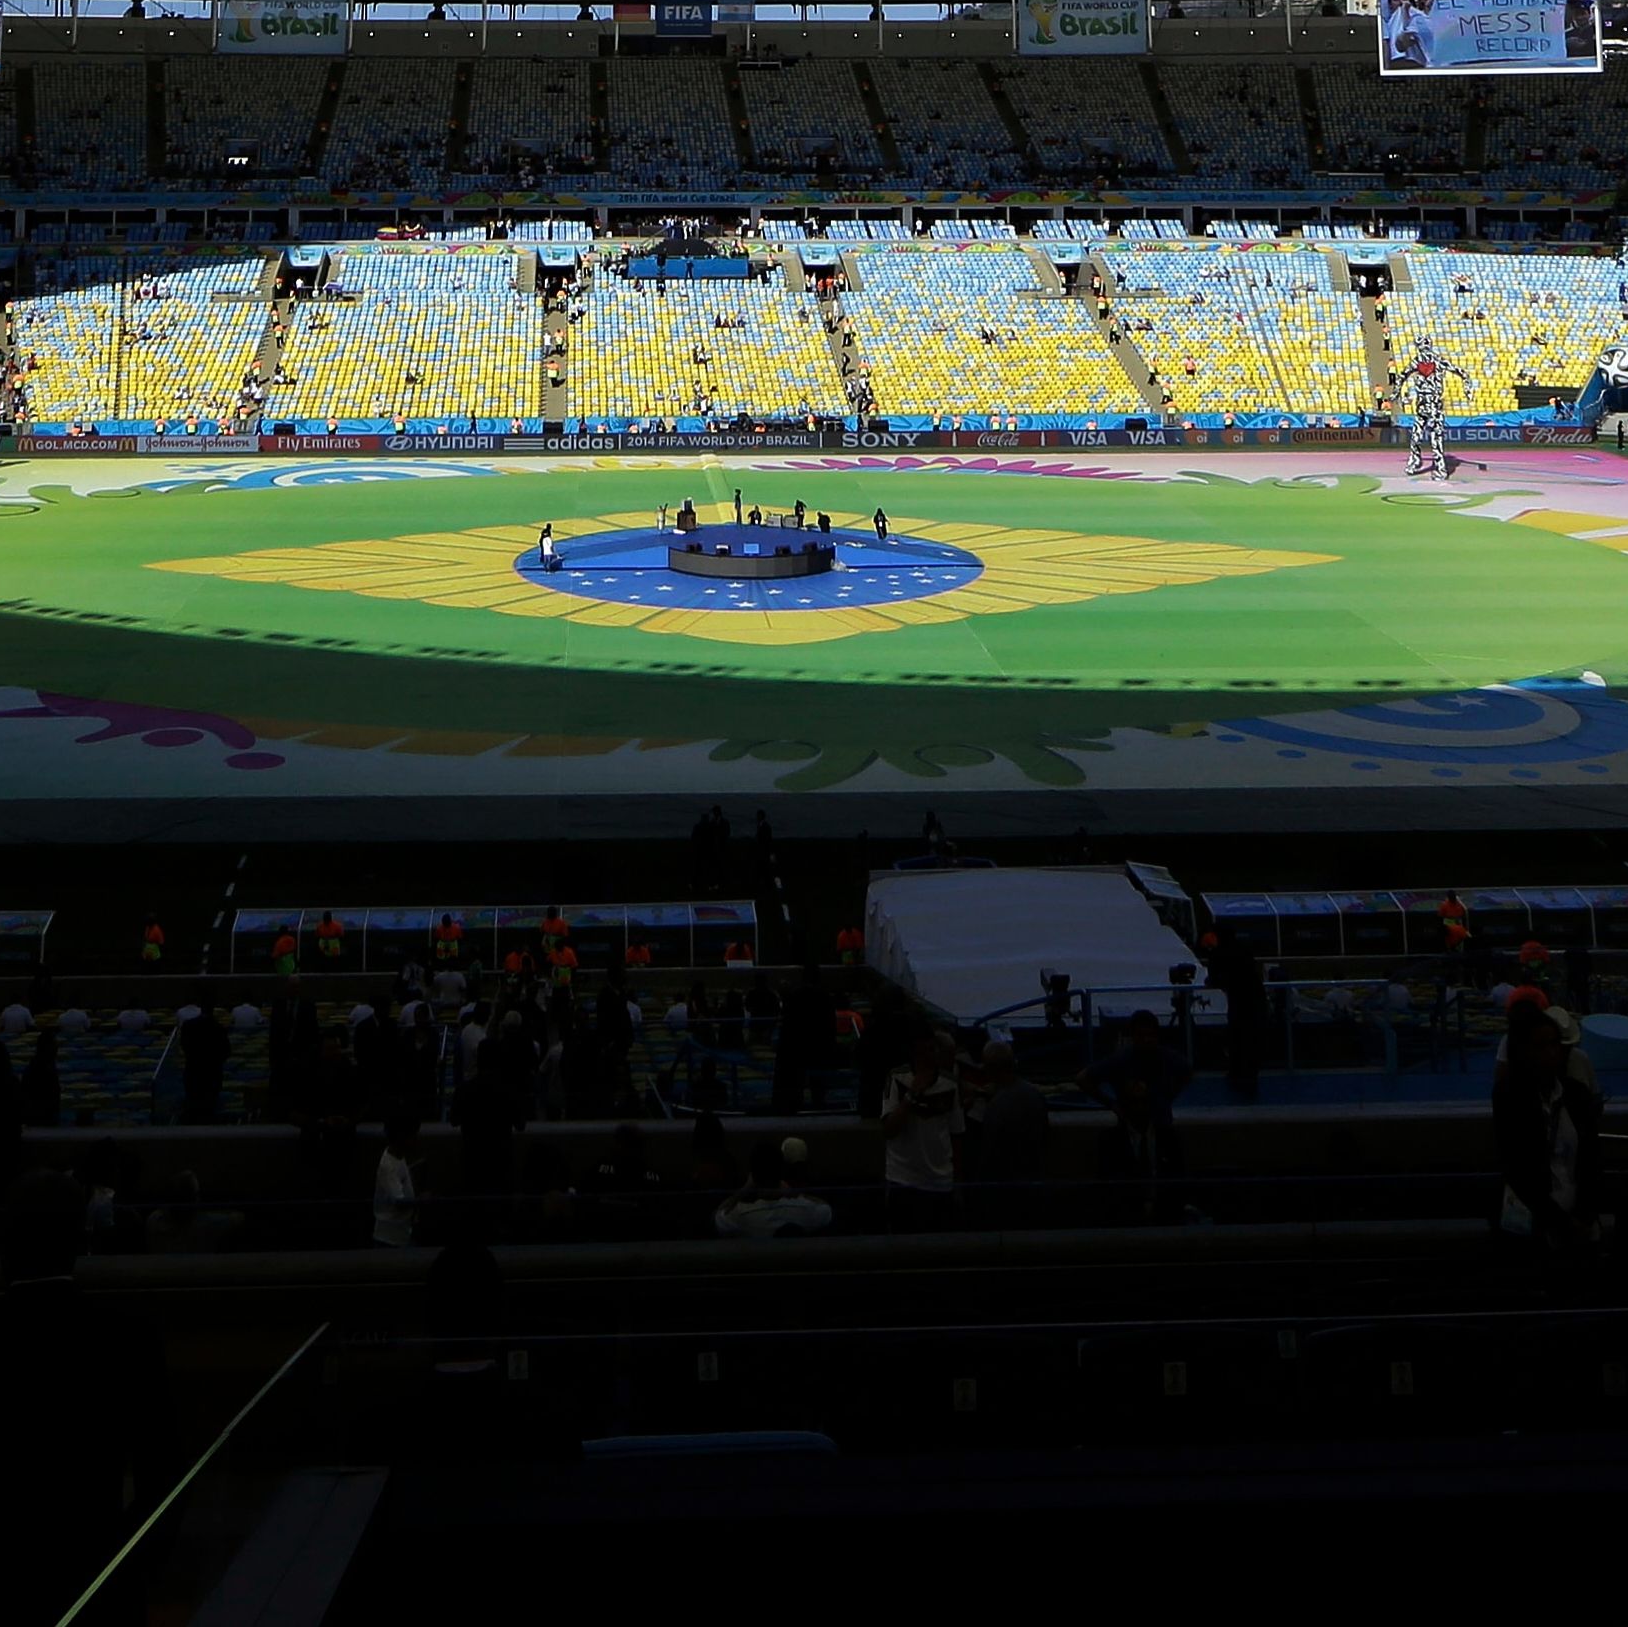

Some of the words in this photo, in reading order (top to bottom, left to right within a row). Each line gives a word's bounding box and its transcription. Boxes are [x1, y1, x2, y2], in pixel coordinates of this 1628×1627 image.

[664, 5, 703, 20] FIFA
[1062, 2, 1082, 10] FIFA
[1083, 2, 1119, 10] WORLD
[1120, 1, 1140, 9] CUP
[1059, 11, 1139, 36] Brasil
[1476, 37, 1552, 53] RECORD
[627, 436, 655, 447] 2014
[659, 436, 685, 446] FIFA
[687, 435, 734, 446] WORLD
[738, 435, 763, 446] CUP
[766, 434, 811, 446] BRAZIL
[841, 432, 921, 448] SONY
[1068, 432, 1108, 445] VISA
[1126, 431, 1166, 445] VISA
[1293, 429, 1364, 443] Continental
[1466, 428, 1521, 441] SOLAR
[35, 438, 118, 451] GOL.MCD.COM
[278, 436, 300, 452] Fly
[303, 436, 361, 449] Emirates
[415, 436, 494, 449] HYUNDAI
[547, 434, 614, 450] adidas
